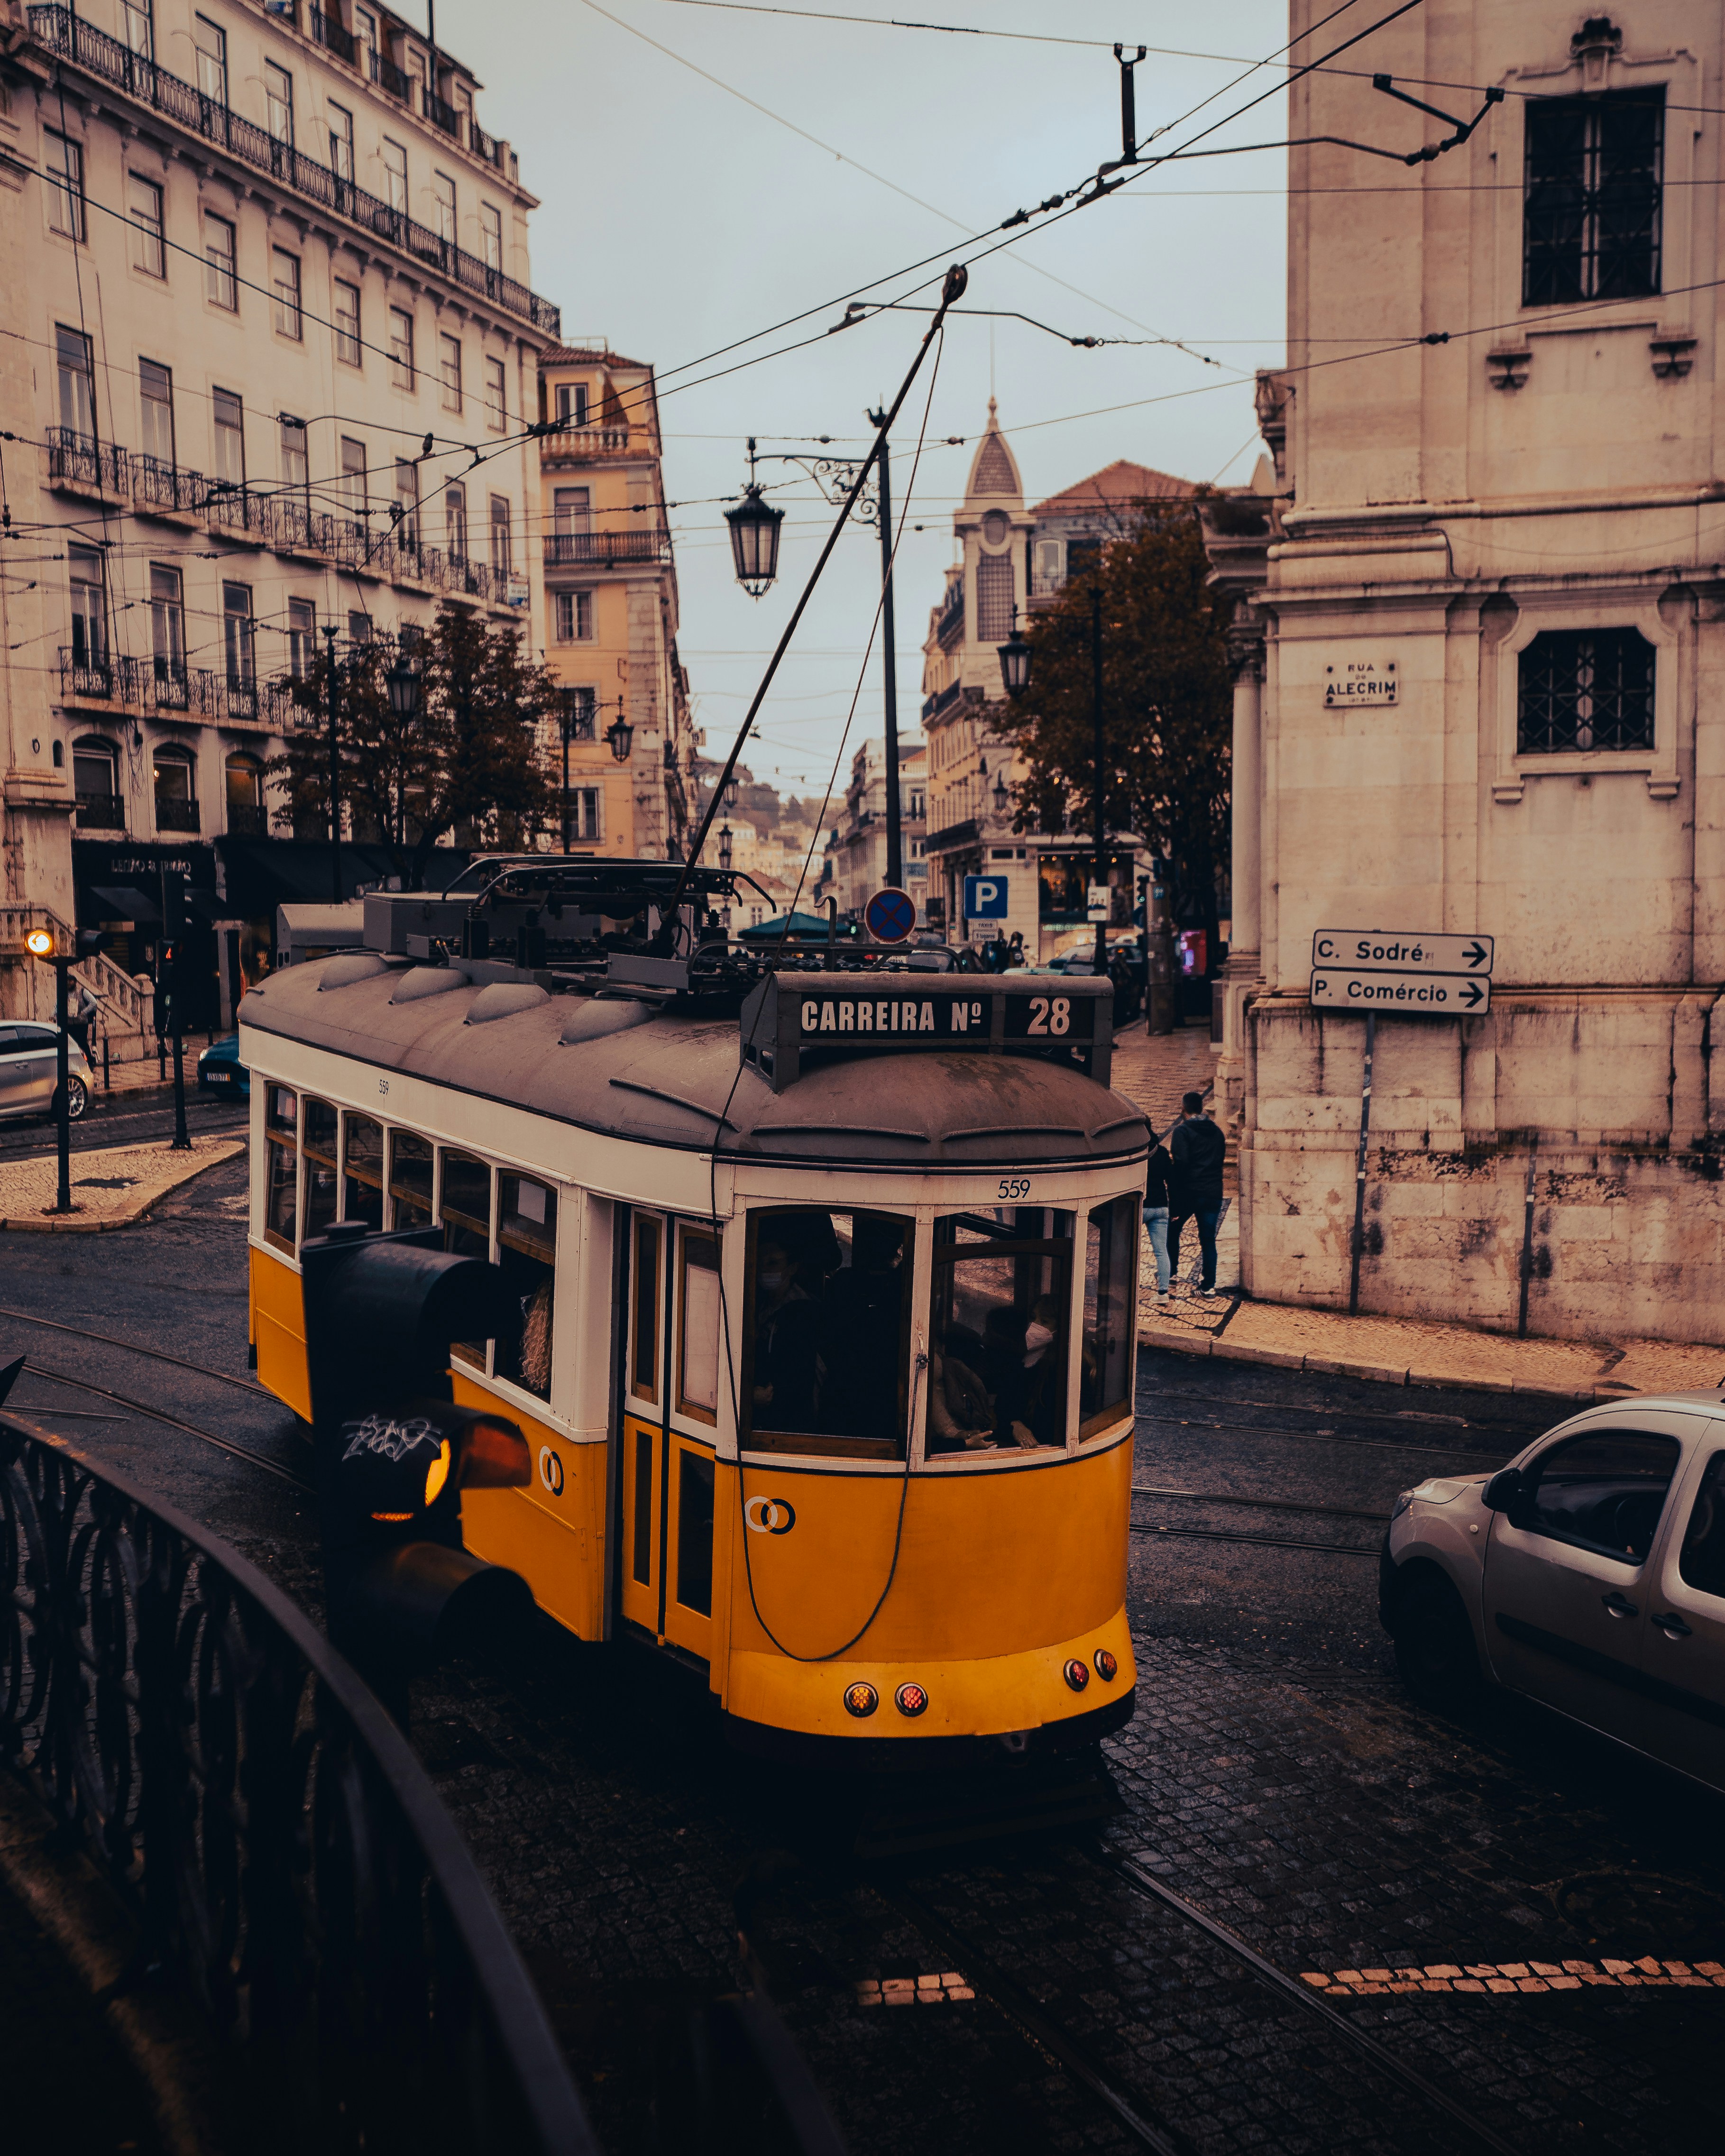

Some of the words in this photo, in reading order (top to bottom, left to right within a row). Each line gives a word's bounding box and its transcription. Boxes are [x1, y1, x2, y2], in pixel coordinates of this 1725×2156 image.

[1348, 664, 1374, 672] RUA
[1326, 680, 1395, 695] ALECRIM
[976, 882, 998, 911] P
[1318, 940, 1340, 958] C.
[1356, 941, 1422, 962] Sodré
[1315, 980, 1333, 997] P.
[1348, 981, 1448, 1002] Comércio
[801, 1001, 935, 1031] CARREIRA
[1027, 997, 1070, 1035] 28
[379, 1079, 389, 1096] 559
[997, 1179, 1031, 1199] 559
